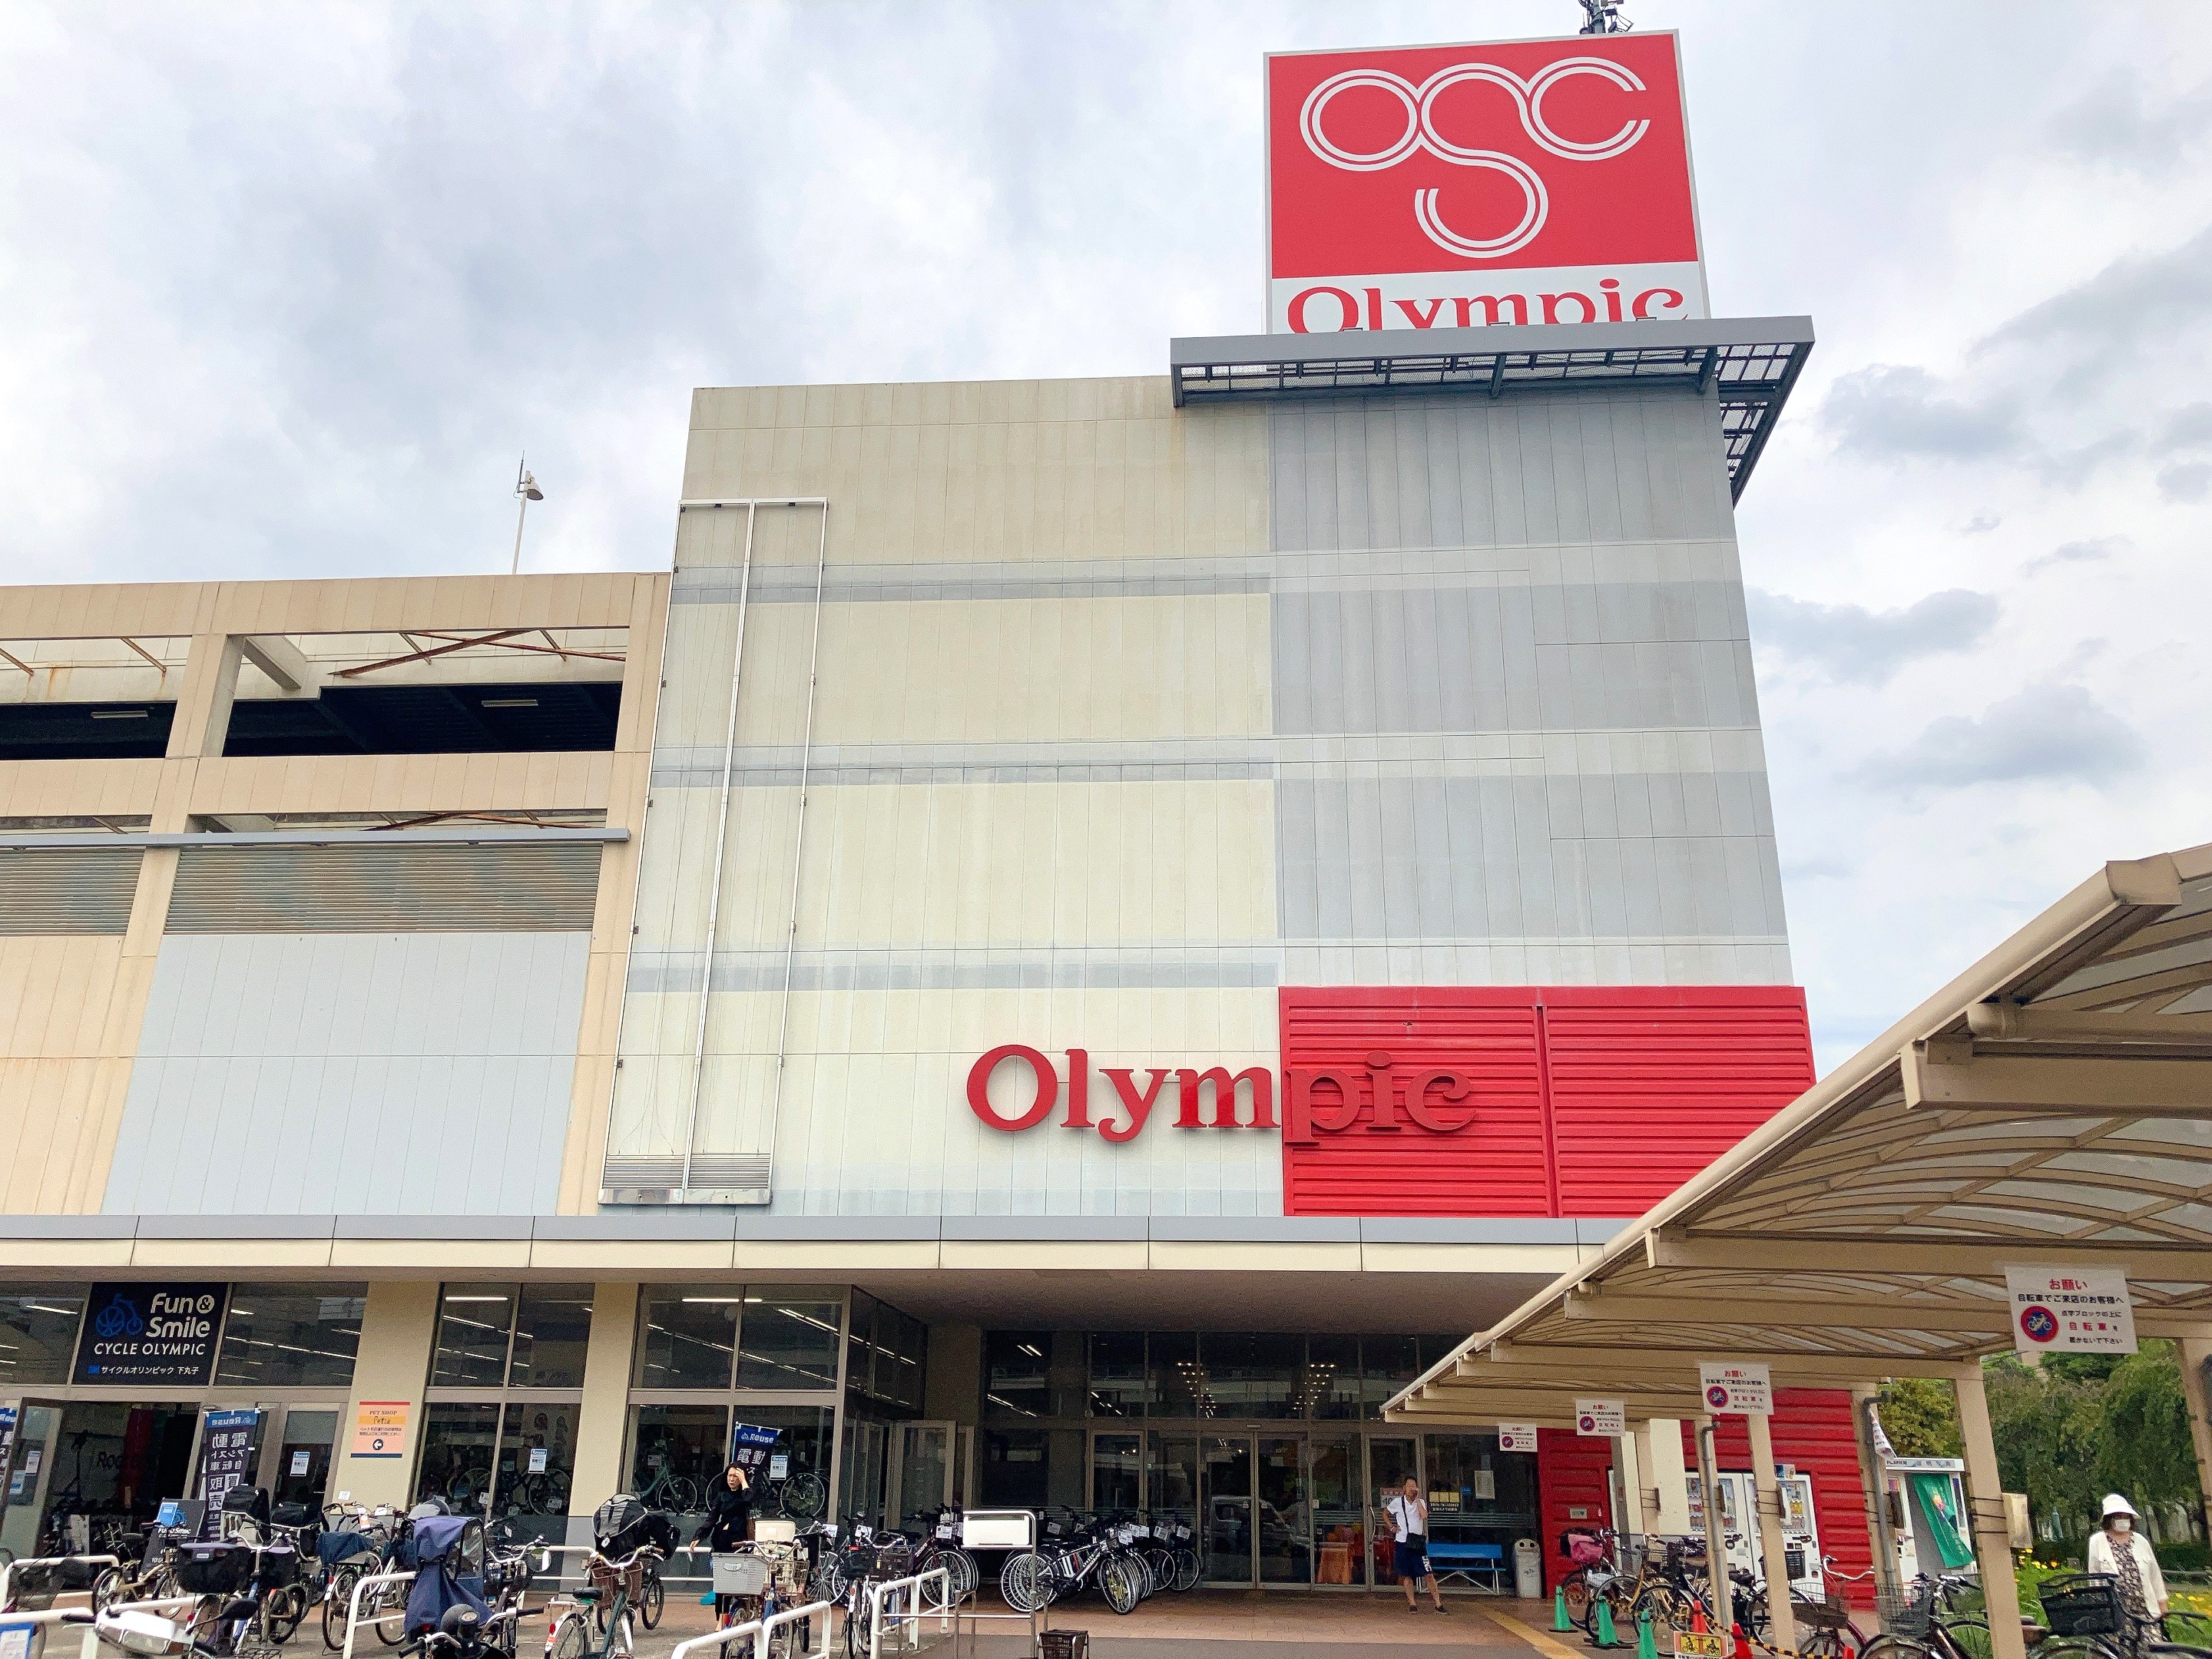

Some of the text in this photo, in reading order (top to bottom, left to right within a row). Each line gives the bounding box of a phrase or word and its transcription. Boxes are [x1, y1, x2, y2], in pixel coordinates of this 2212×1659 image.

[1287, 278, 1689, 334] Olympic
[966, 1044, 1477, 1146] Olympic
[2049, 1279, 2088, 1290] お願い
[150, 1293, 194, 1314] Fun
[2018, 1293, 2124, 1304] 自転車でご来店のお客様へ
[145, 1316, 210, 1338] Smile
[94, 1343, 206, 1355] CYCLE OLYMPIC
[101, 1366, 200, 1375] サイクルオリンピック 下丸子
[749, 1433, 774, 1443] Reuse
[737, 1448, 767, 1465] 電動
